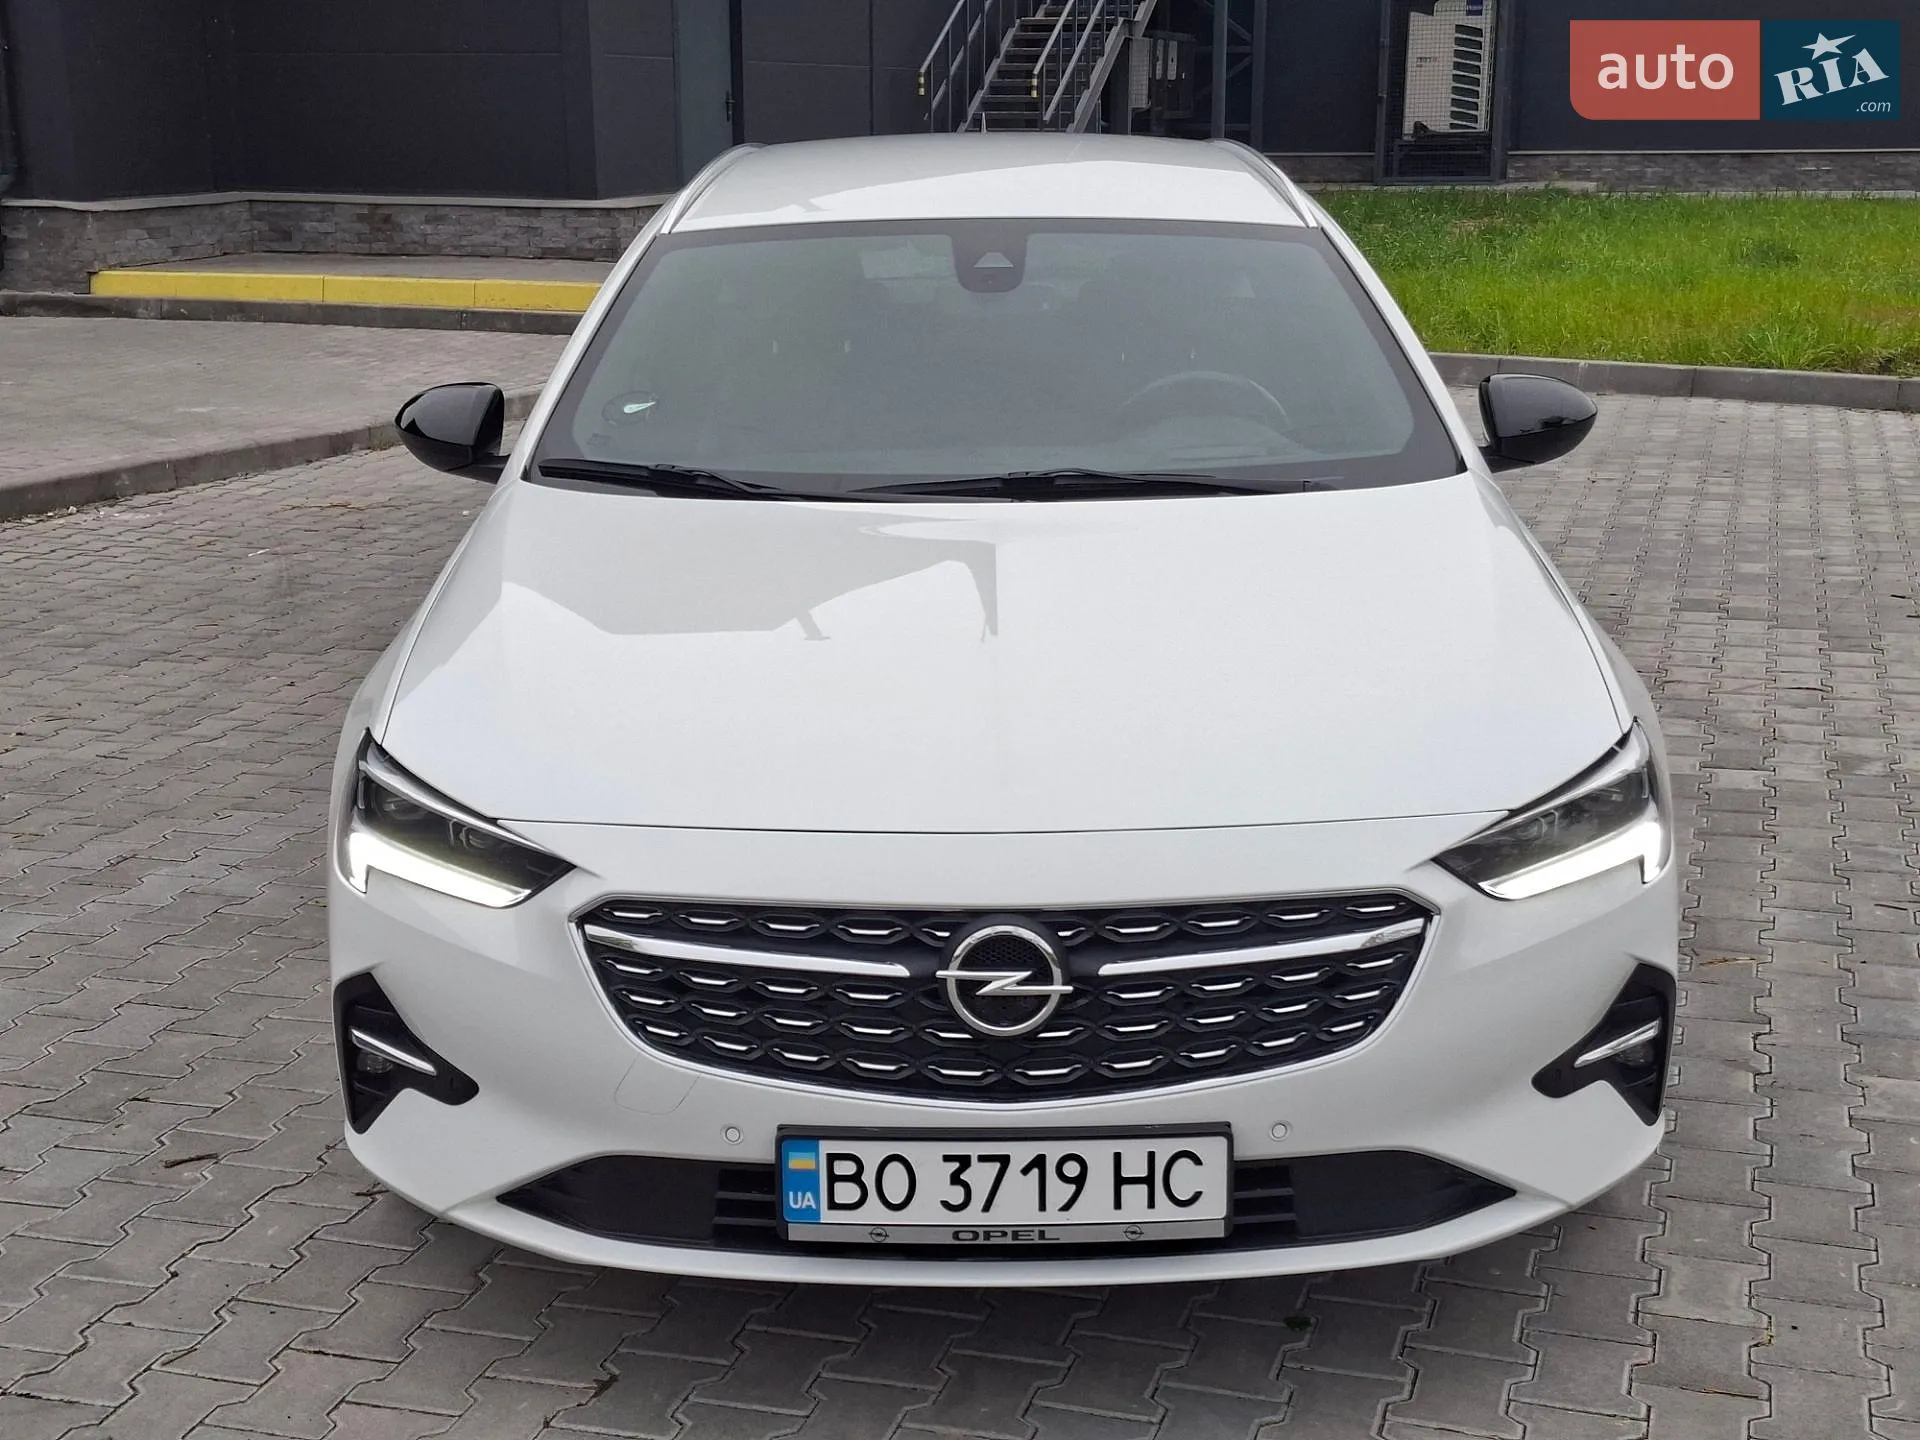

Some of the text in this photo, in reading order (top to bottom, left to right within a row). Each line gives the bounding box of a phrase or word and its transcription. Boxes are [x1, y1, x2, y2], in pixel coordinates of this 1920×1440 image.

[825, 1149, 1204, 1213] BO 3719 HC
[788, 1191, 816, 1210] UA
[951, 1229, 1060, 1242] OPEL
